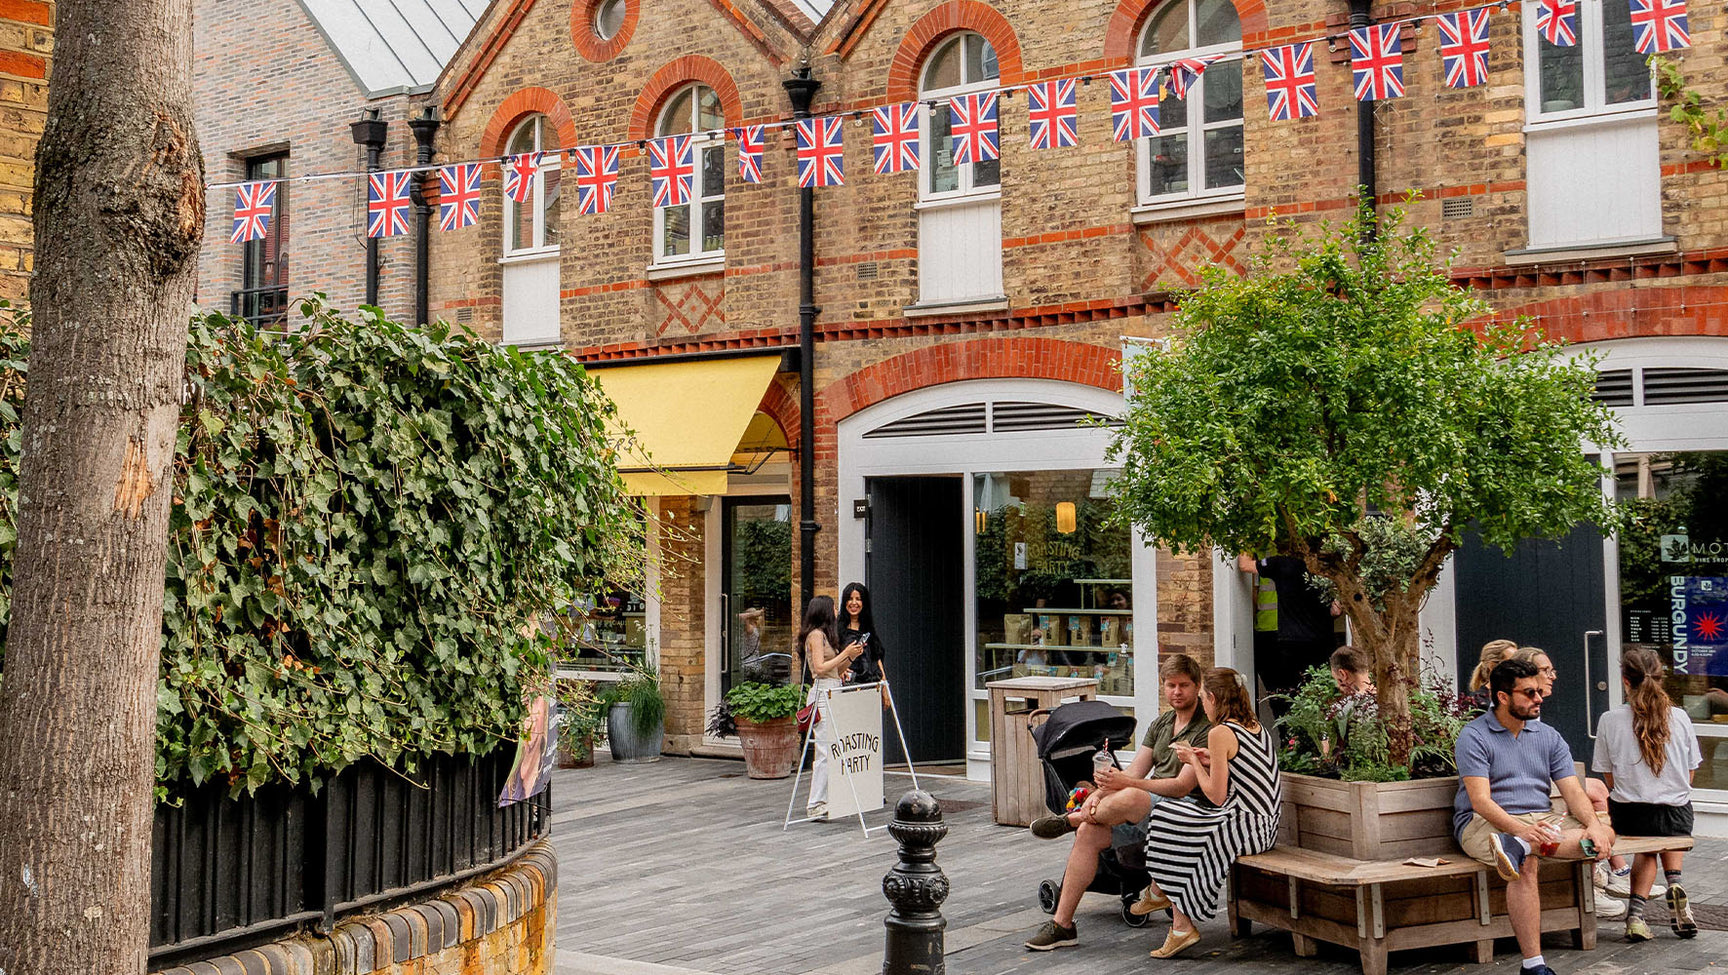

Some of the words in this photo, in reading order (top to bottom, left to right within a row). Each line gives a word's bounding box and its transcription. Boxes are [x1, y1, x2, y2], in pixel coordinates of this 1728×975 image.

[1036, 560, 1069, 577] PARTY
[1671, 576, 1688, 674] BURGUNDY
[831, 733, 879, 760] ROASTING
